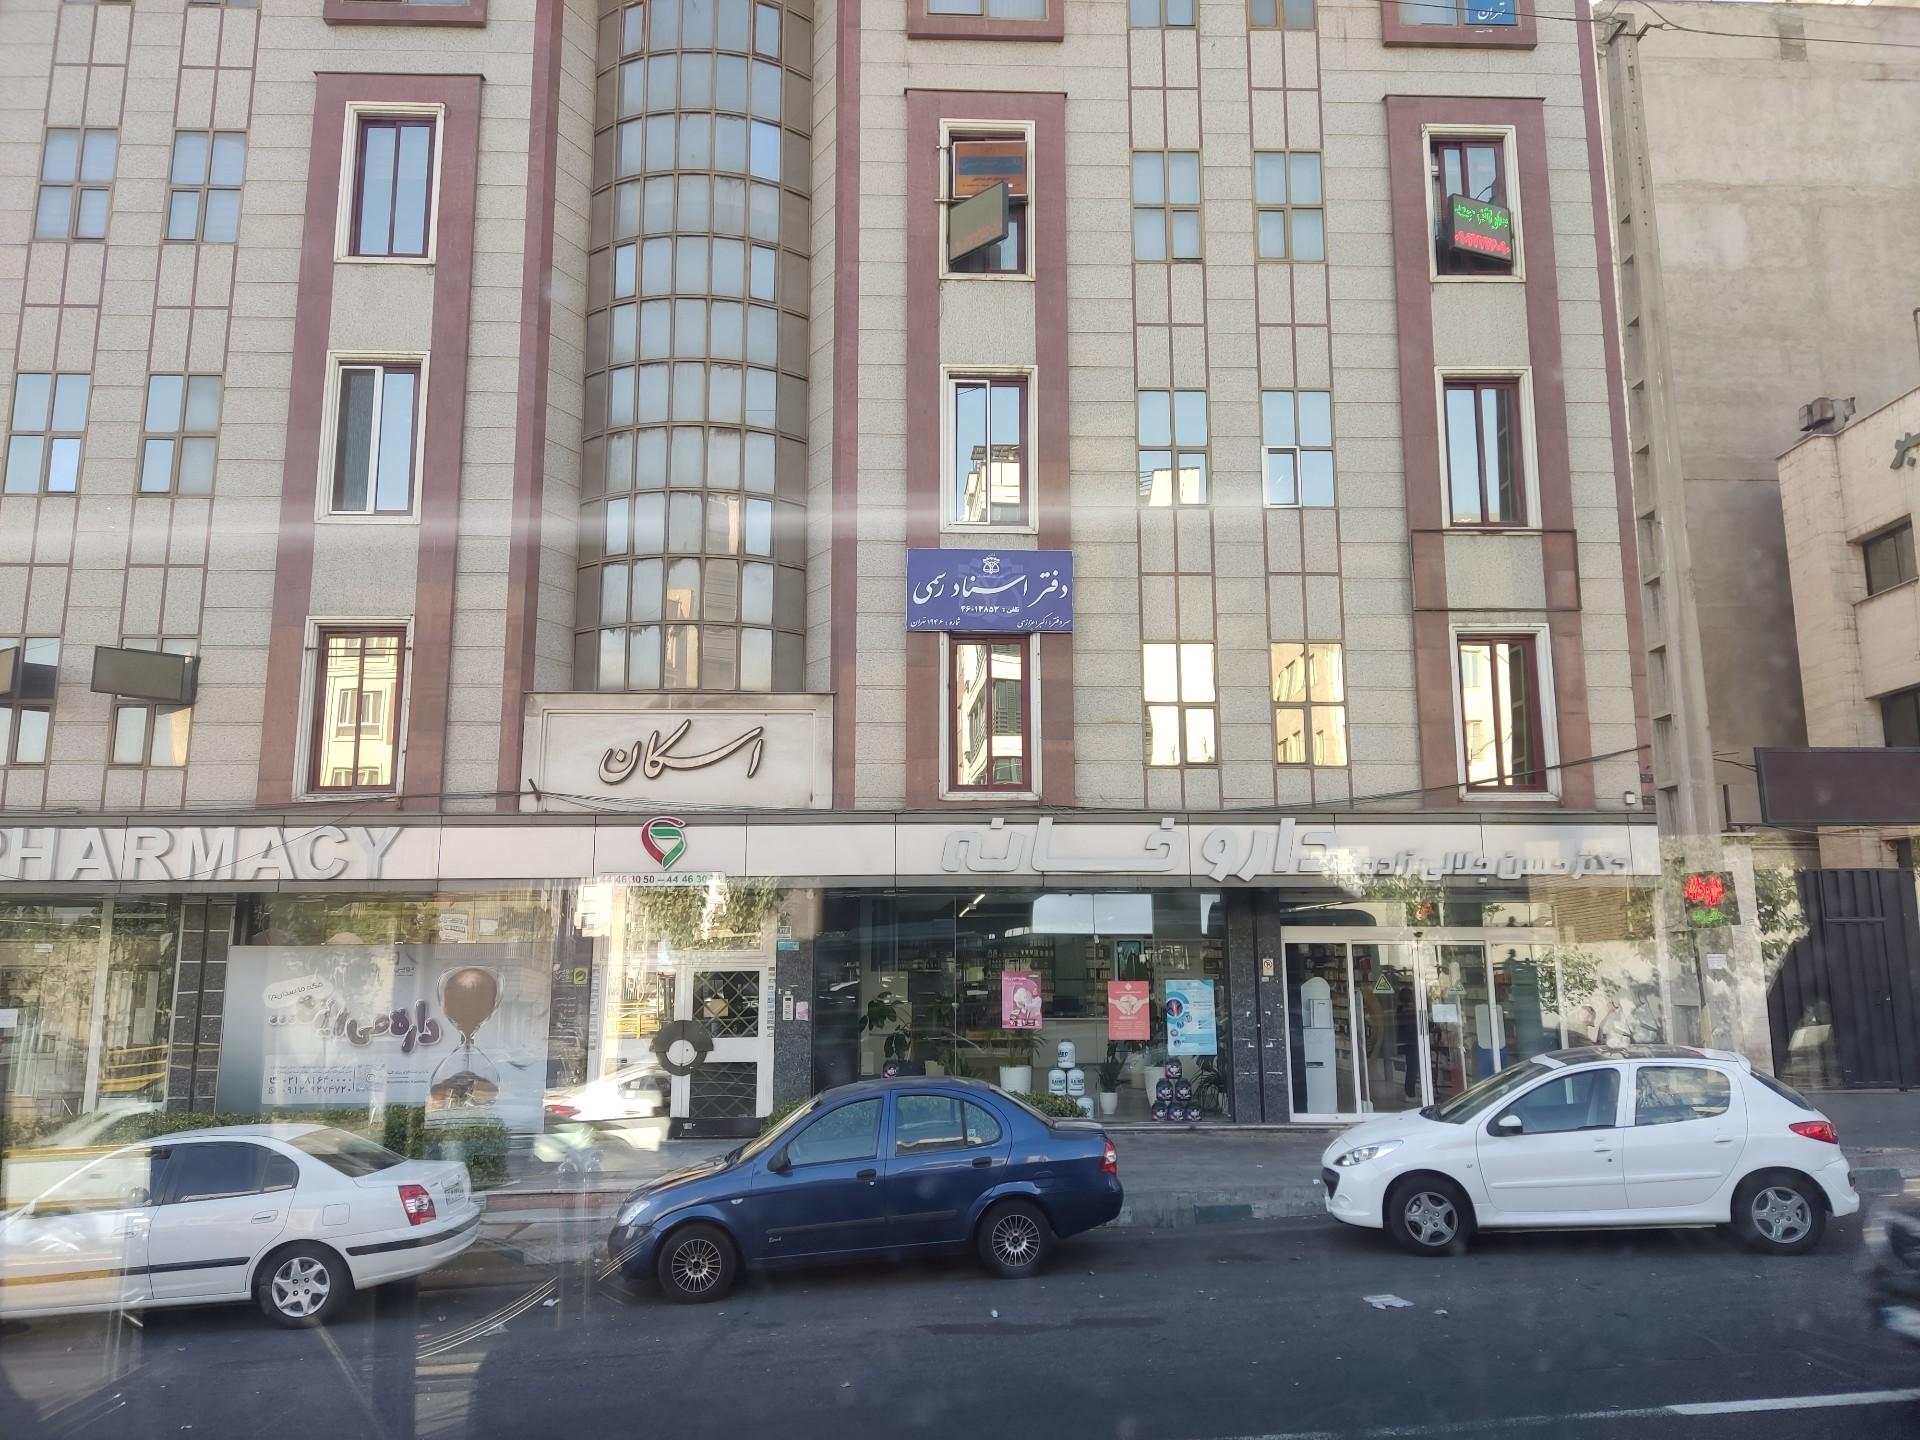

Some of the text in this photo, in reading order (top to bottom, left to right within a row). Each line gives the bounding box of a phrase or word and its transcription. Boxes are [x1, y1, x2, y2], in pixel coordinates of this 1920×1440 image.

[912, 569, 1068, 607] دفتر اسناد رسمی
[598, 718, 764, 785] اسکان
[0, 825, 402, 881] HARMACY
[1496, 852, 1567, 880] حسن
[643, 875, 655, 884] 50
